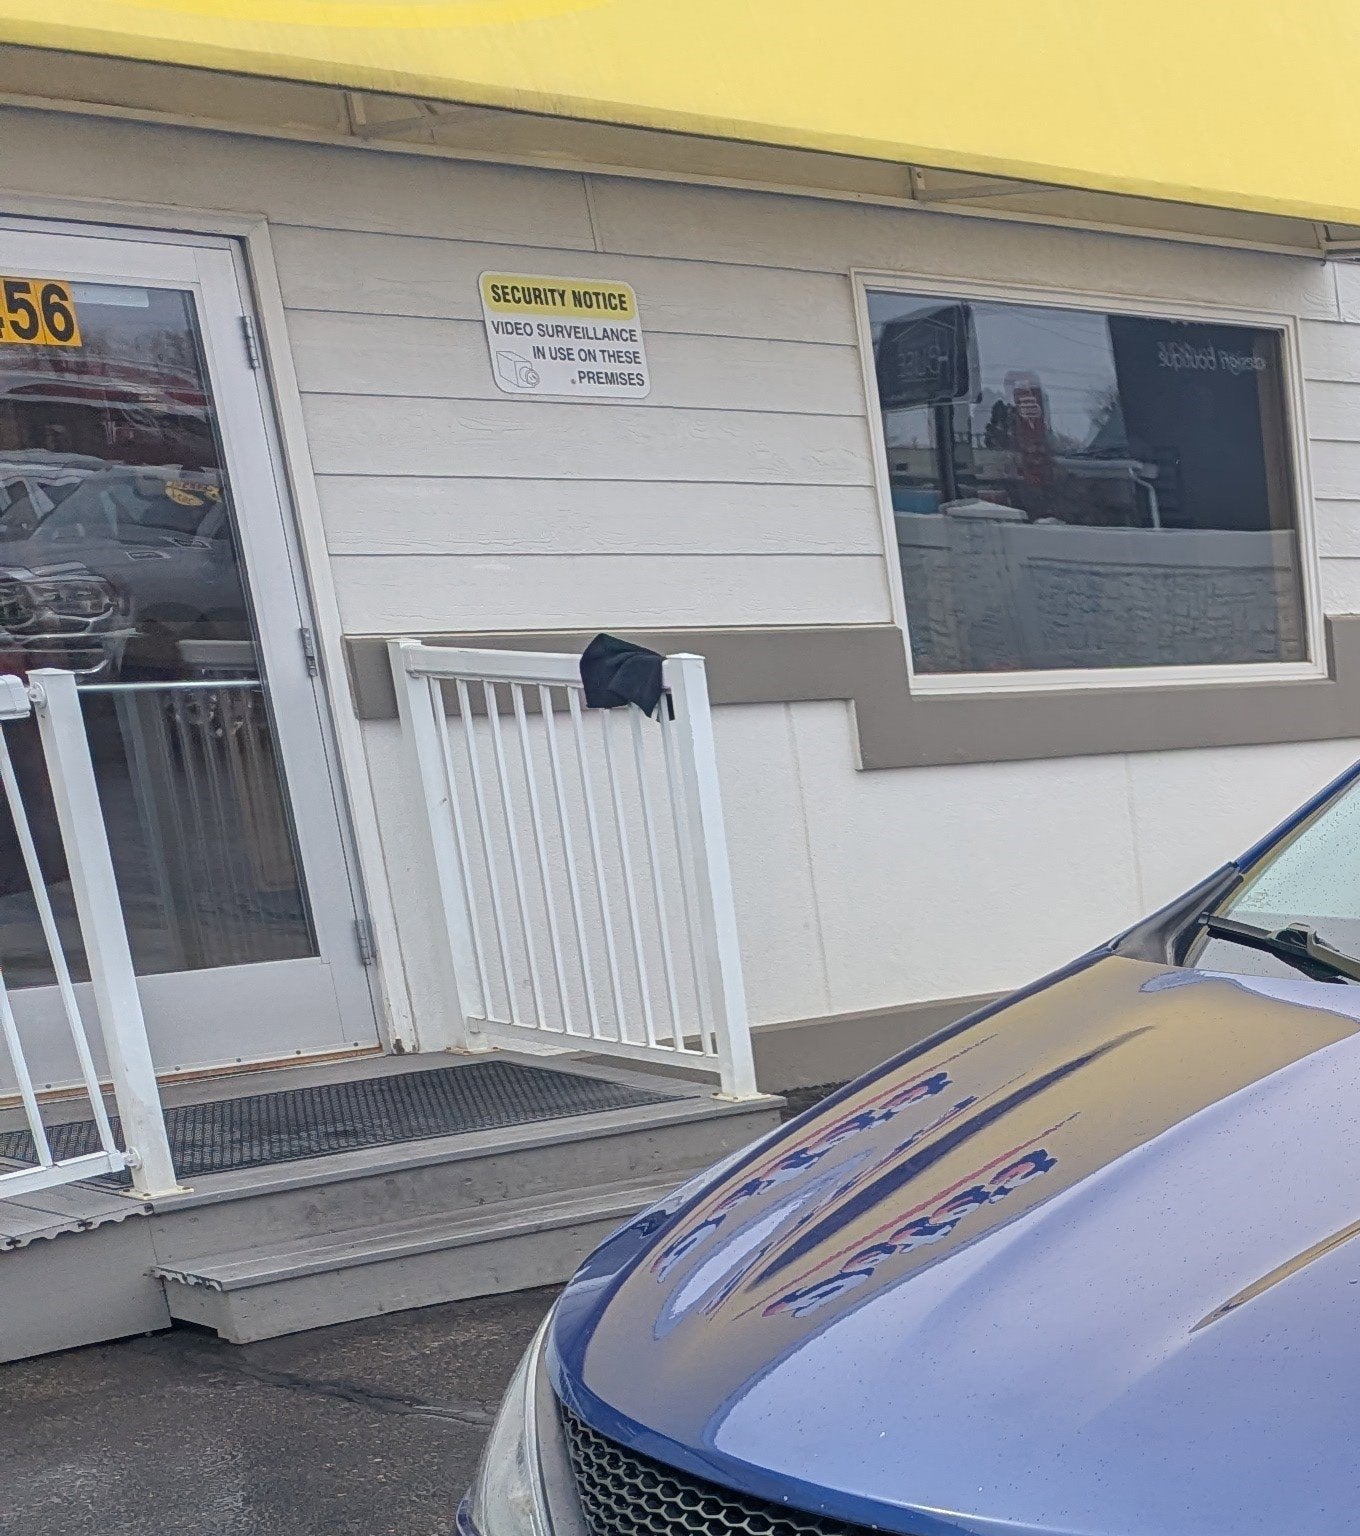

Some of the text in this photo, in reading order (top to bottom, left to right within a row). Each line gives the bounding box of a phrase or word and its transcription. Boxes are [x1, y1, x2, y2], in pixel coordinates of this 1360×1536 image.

[491, 284, 628, 311] SECURITY NOTICE
[0, 281, 75, 342] 56
[491, 320, 638, 343] VIDEO SURVEILLANCE
[532, 345, 642, 365] IN USE ON THESE
[578, 370, 645, 387] PREMISES
